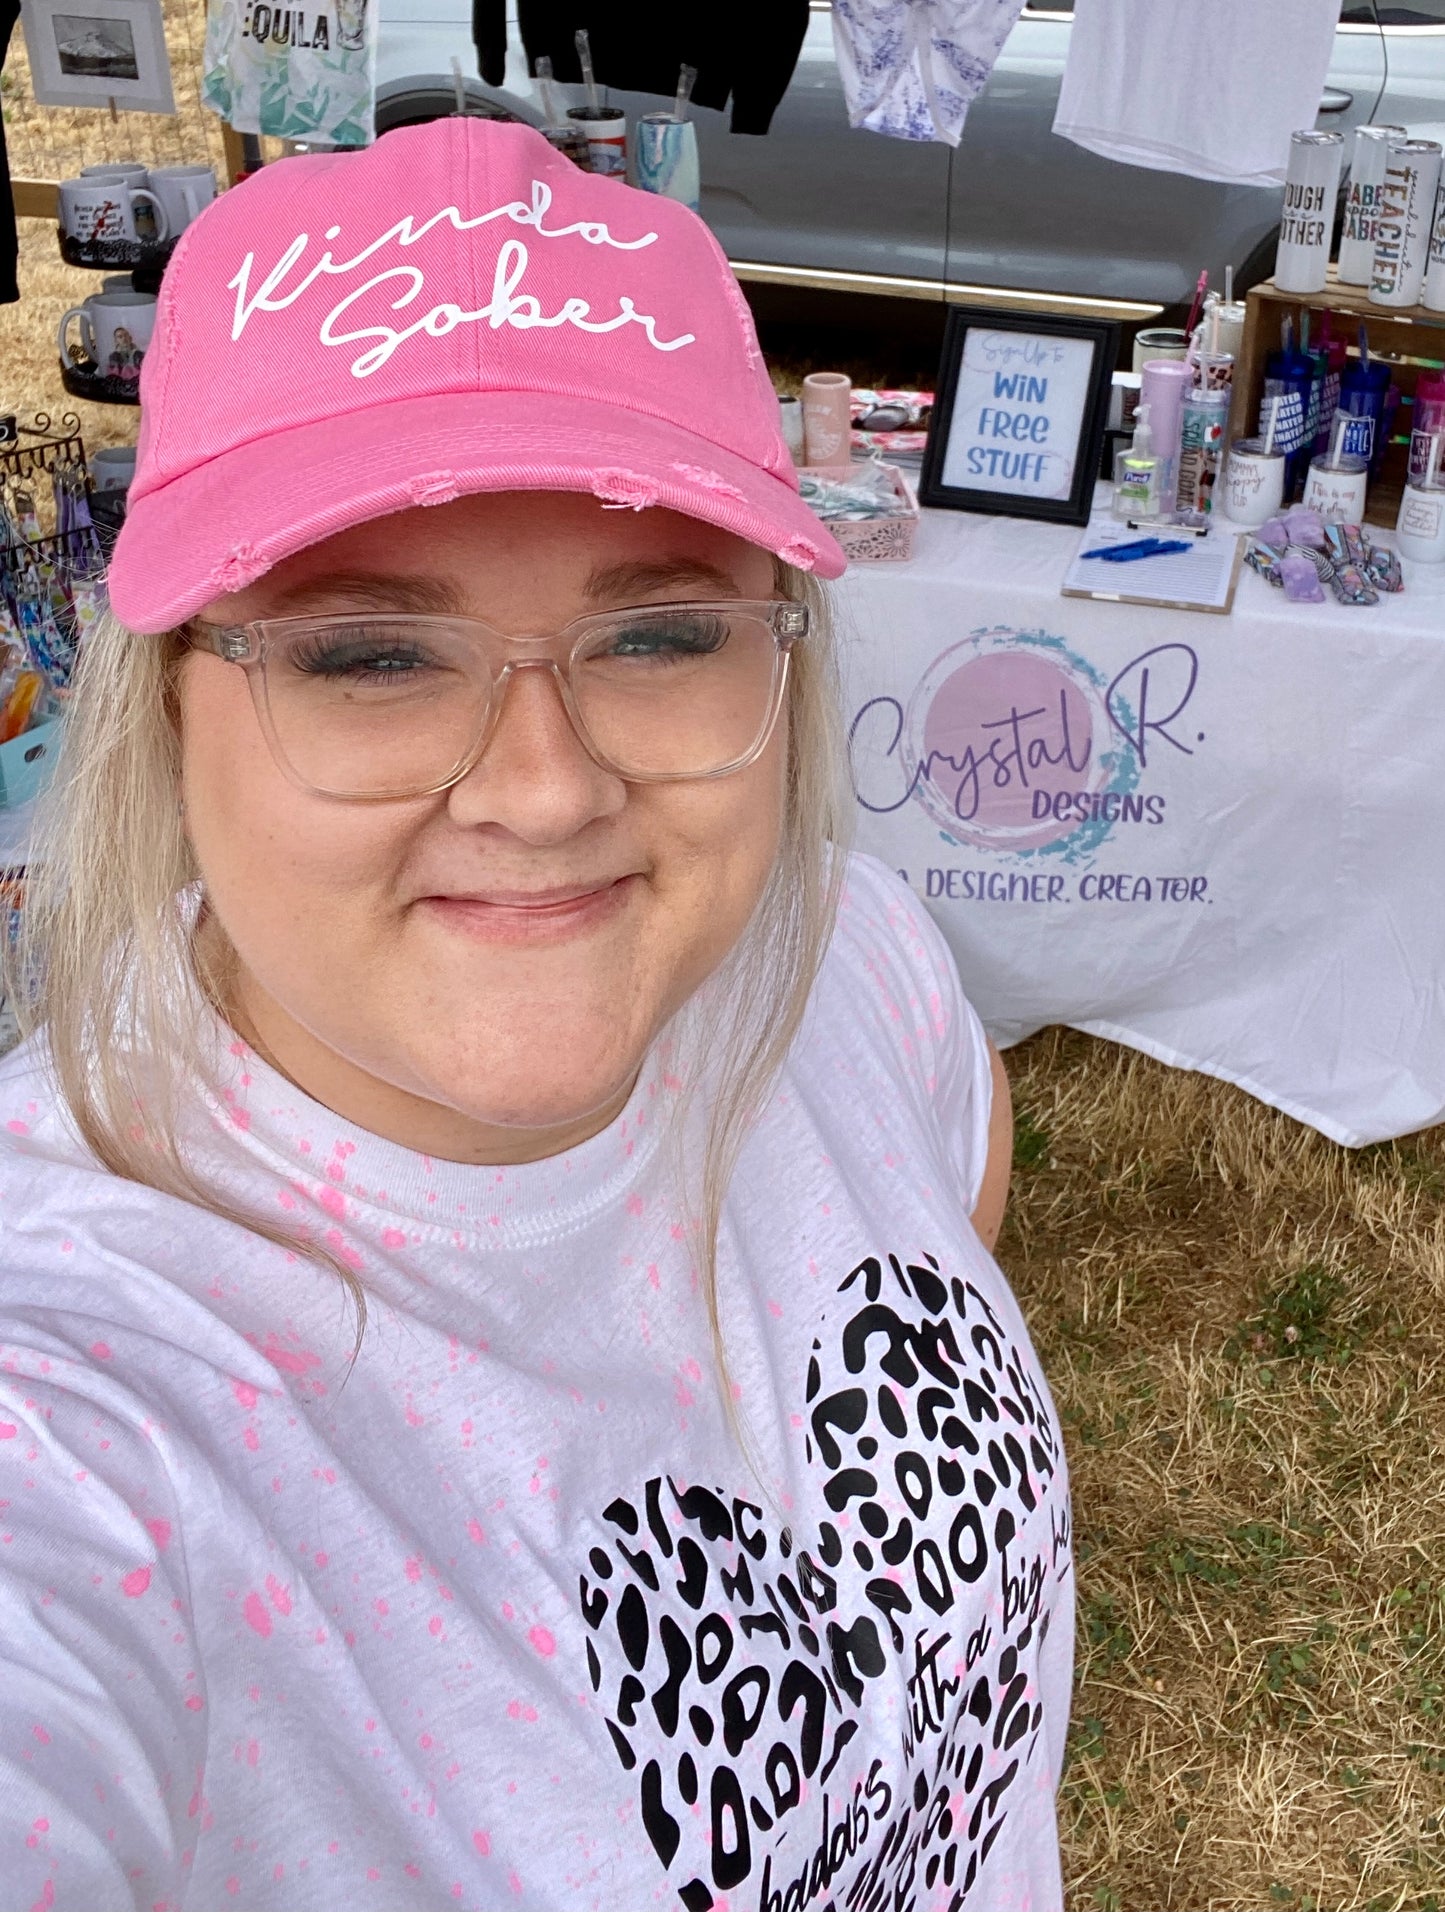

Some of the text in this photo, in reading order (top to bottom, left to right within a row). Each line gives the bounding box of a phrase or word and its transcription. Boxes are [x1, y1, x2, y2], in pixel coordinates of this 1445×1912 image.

[1285, 181, 1325, 212] OUGH
[1371, 166, 1411, 294] TEACHER
[226, 179, 659, 341] Kinda
[1280, 218, 1325, 246] OTHER
[320, 239, 696, 378] Sober
[966, 446, 1051, 482] STUFF
[1180, 421, 1201, 466] SQUAD
[848, 689, 1092, 821] Crystal
[1078, 873, 1214, 904] CREATOR.
[1001, 1546, 1048, 1635] big
